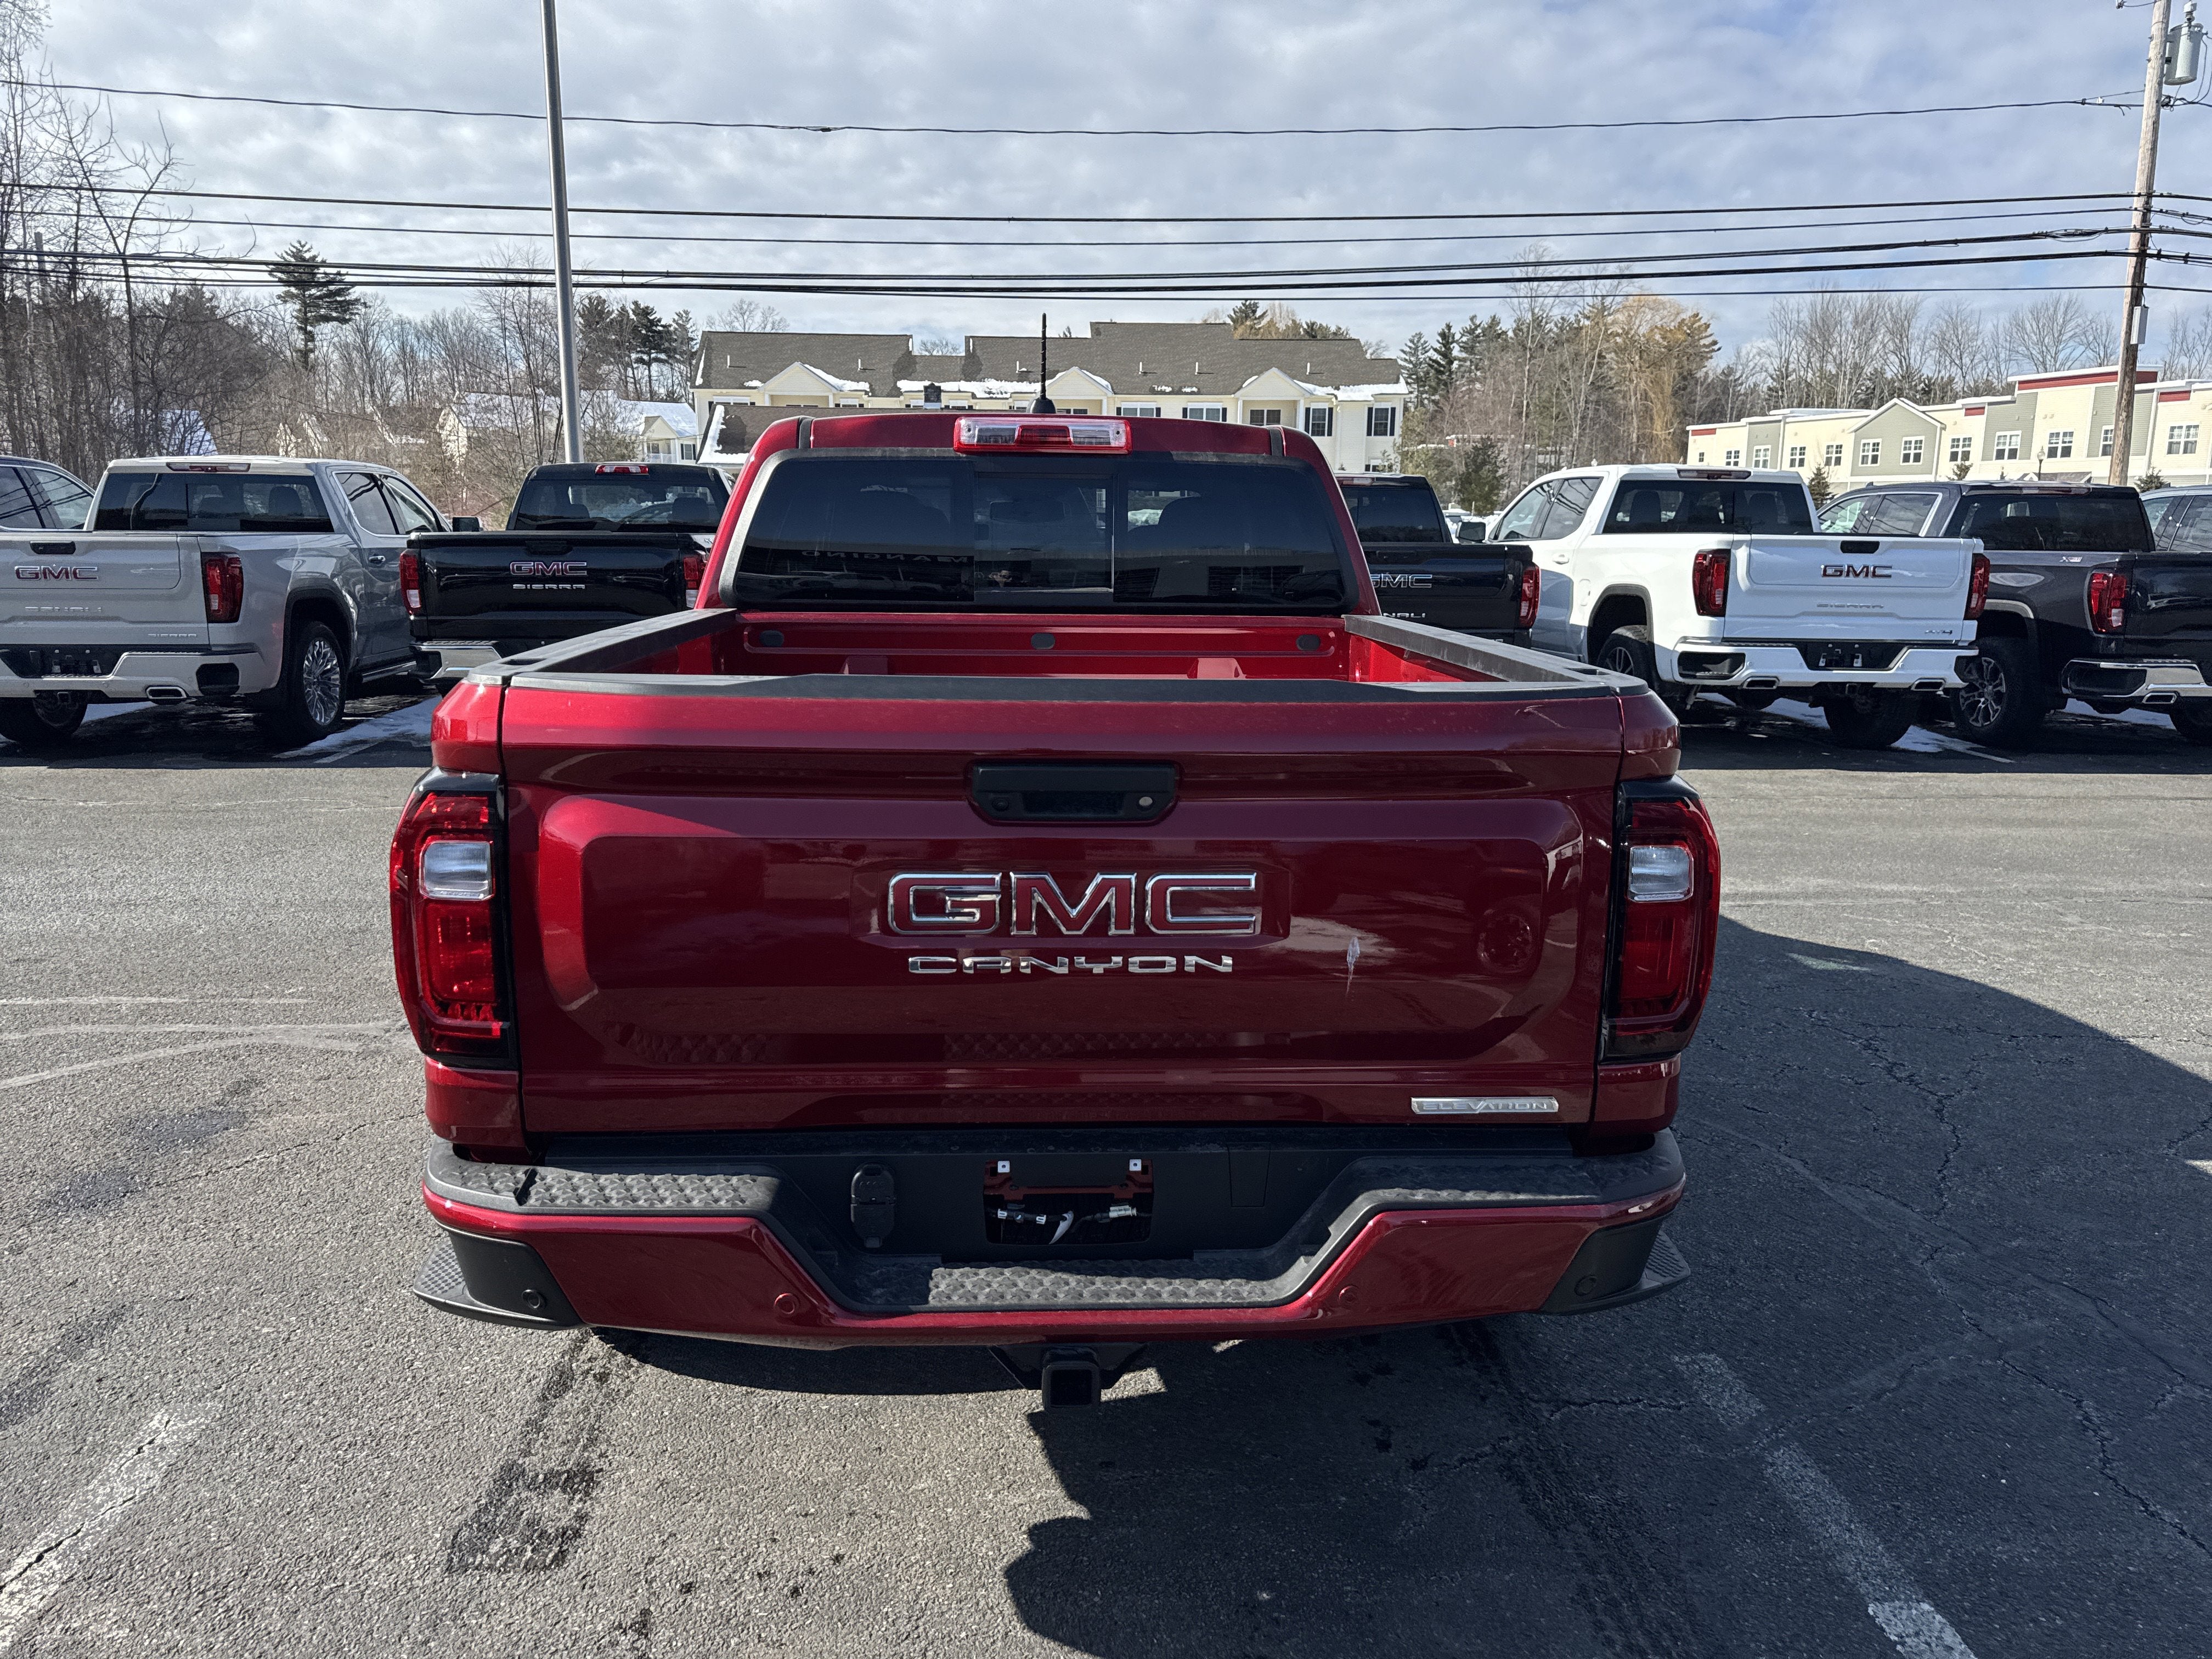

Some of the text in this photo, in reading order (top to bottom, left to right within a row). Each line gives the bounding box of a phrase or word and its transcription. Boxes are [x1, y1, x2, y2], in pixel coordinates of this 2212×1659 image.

[14, 566, 99, 580] GMC
[510, 561, 587, 575] GMC
[1821, 564, 1893, 578] GMC
[888, 871, 1257, 936] GMC
[907, 955, 1233, 973] CANYON
[1422, 1100, 1548, 1111] ELEVATION
